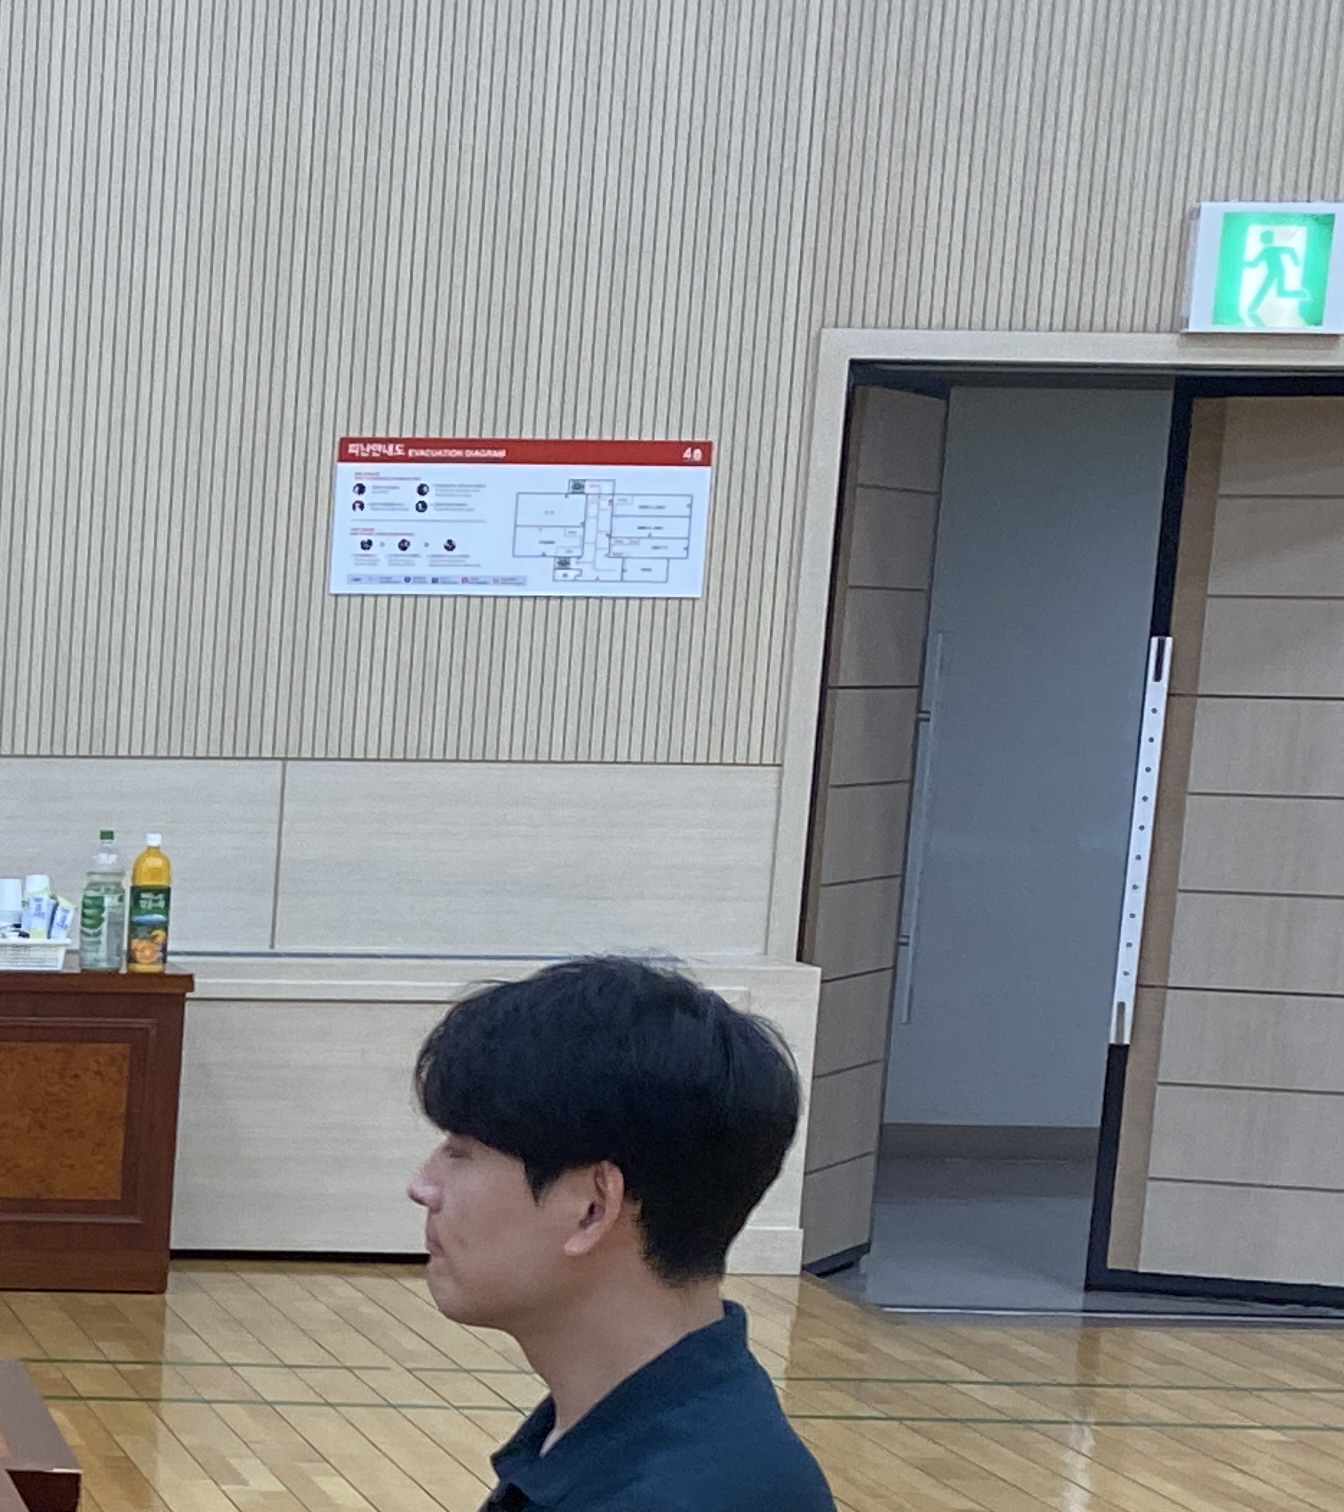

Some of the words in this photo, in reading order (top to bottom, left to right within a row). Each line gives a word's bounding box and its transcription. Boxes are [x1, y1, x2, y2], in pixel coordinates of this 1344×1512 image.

[348, 443, 405, 457] 피난안내도
[408, 449, 462, 458] EVACUATION
[464, 449, 506, 459] DIAGRAM
